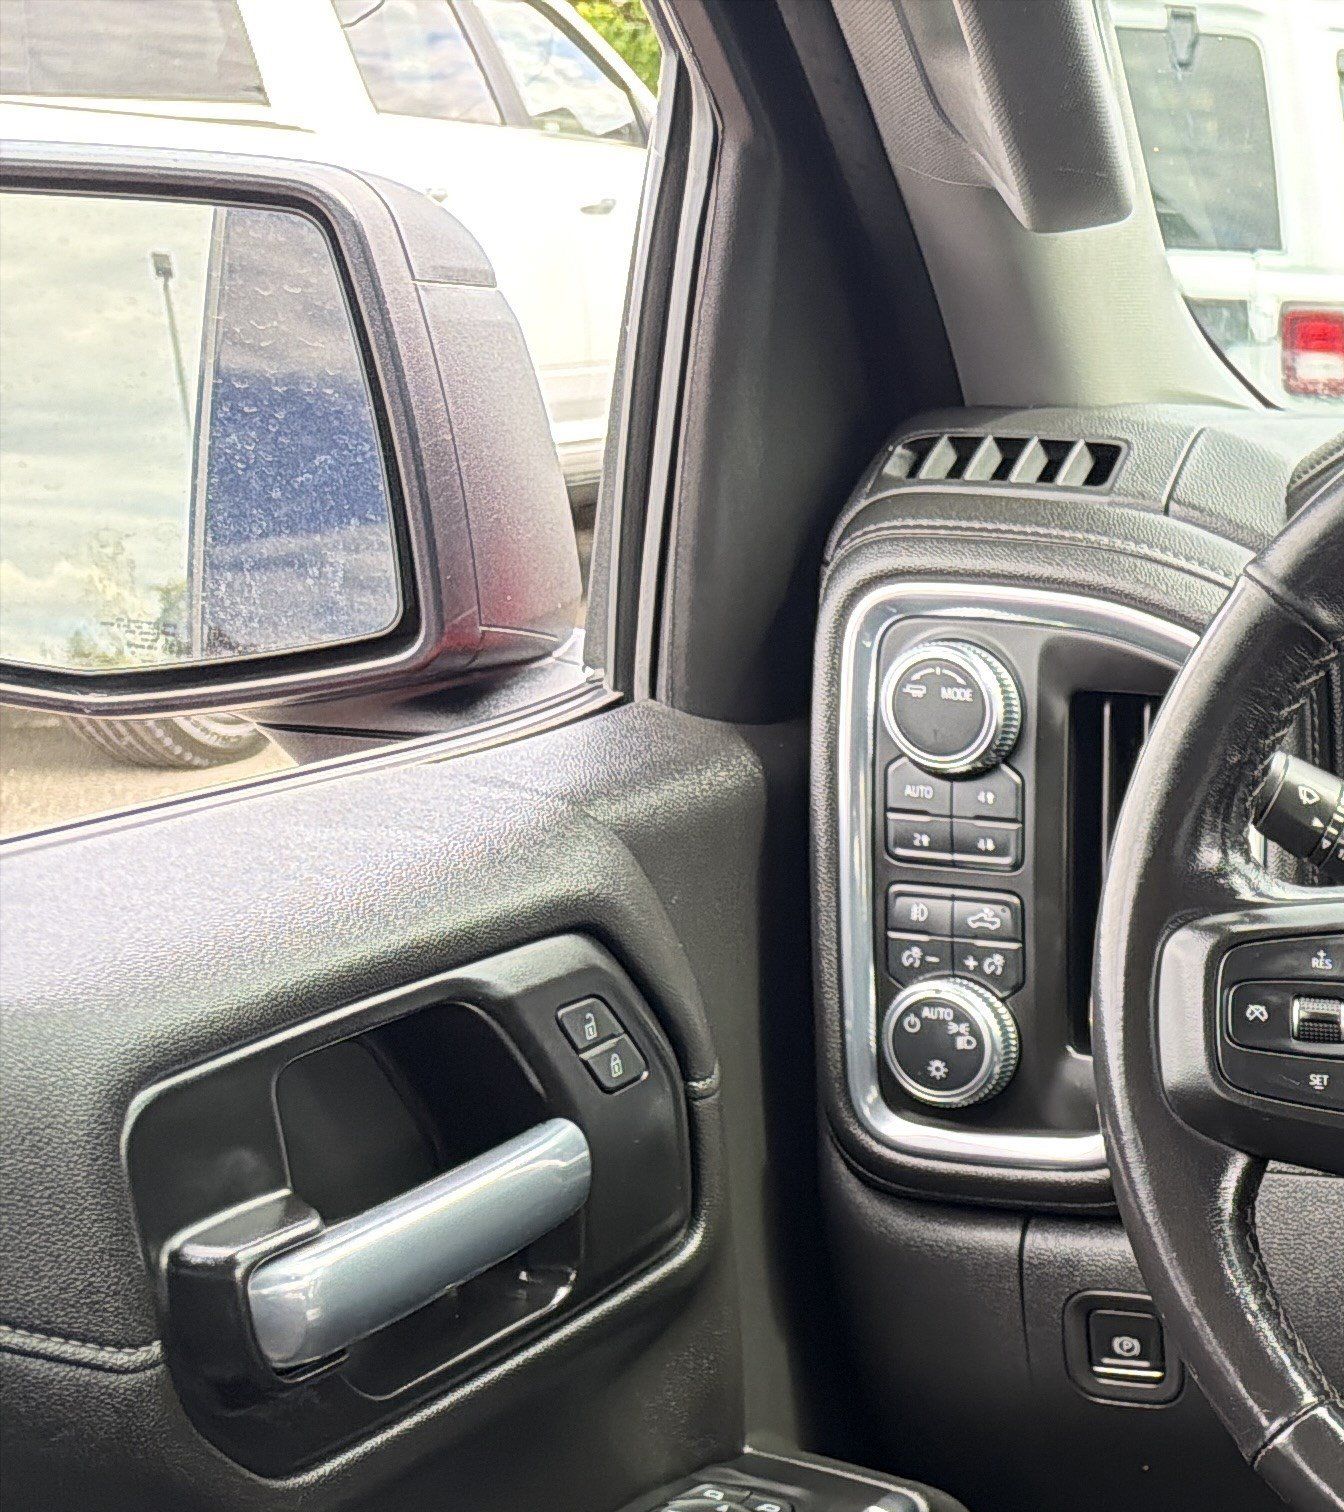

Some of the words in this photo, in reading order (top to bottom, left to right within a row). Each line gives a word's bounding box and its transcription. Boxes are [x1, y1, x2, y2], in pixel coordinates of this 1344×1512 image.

[941, 687, 973, 701] MODE
[904, 785, 933, 799] AUTO
[1311, 957, 1333, 970] RES
[921, 1007, 954, 1021] AUTO
[1309, 1074, 1329, 1087] SET
